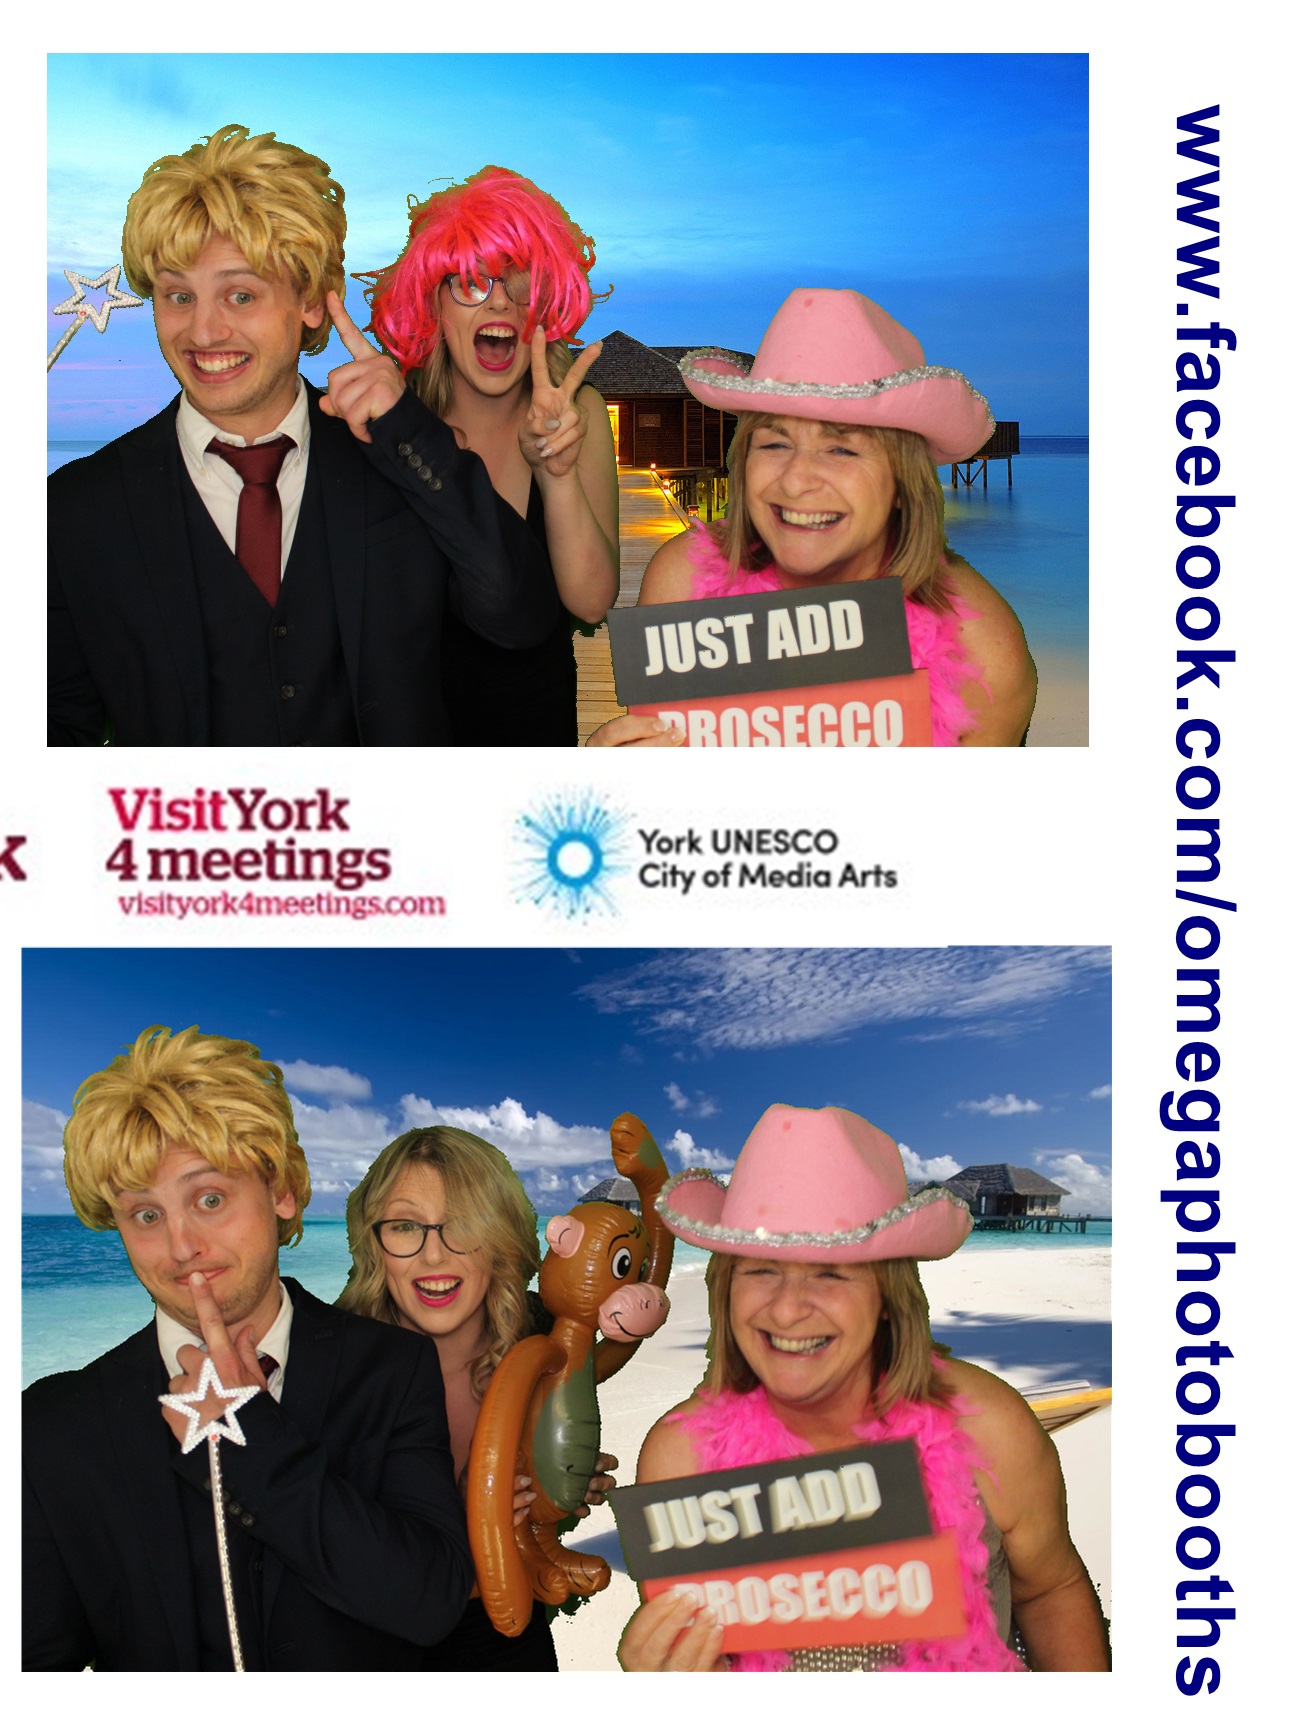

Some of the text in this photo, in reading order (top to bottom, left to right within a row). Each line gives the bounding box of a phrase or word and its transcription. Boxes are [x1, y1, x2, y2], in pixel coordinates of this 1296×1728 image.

[645, 600, 864, 676] JUST ADD
[643, 1462, 881, 1553] JUST ADD
